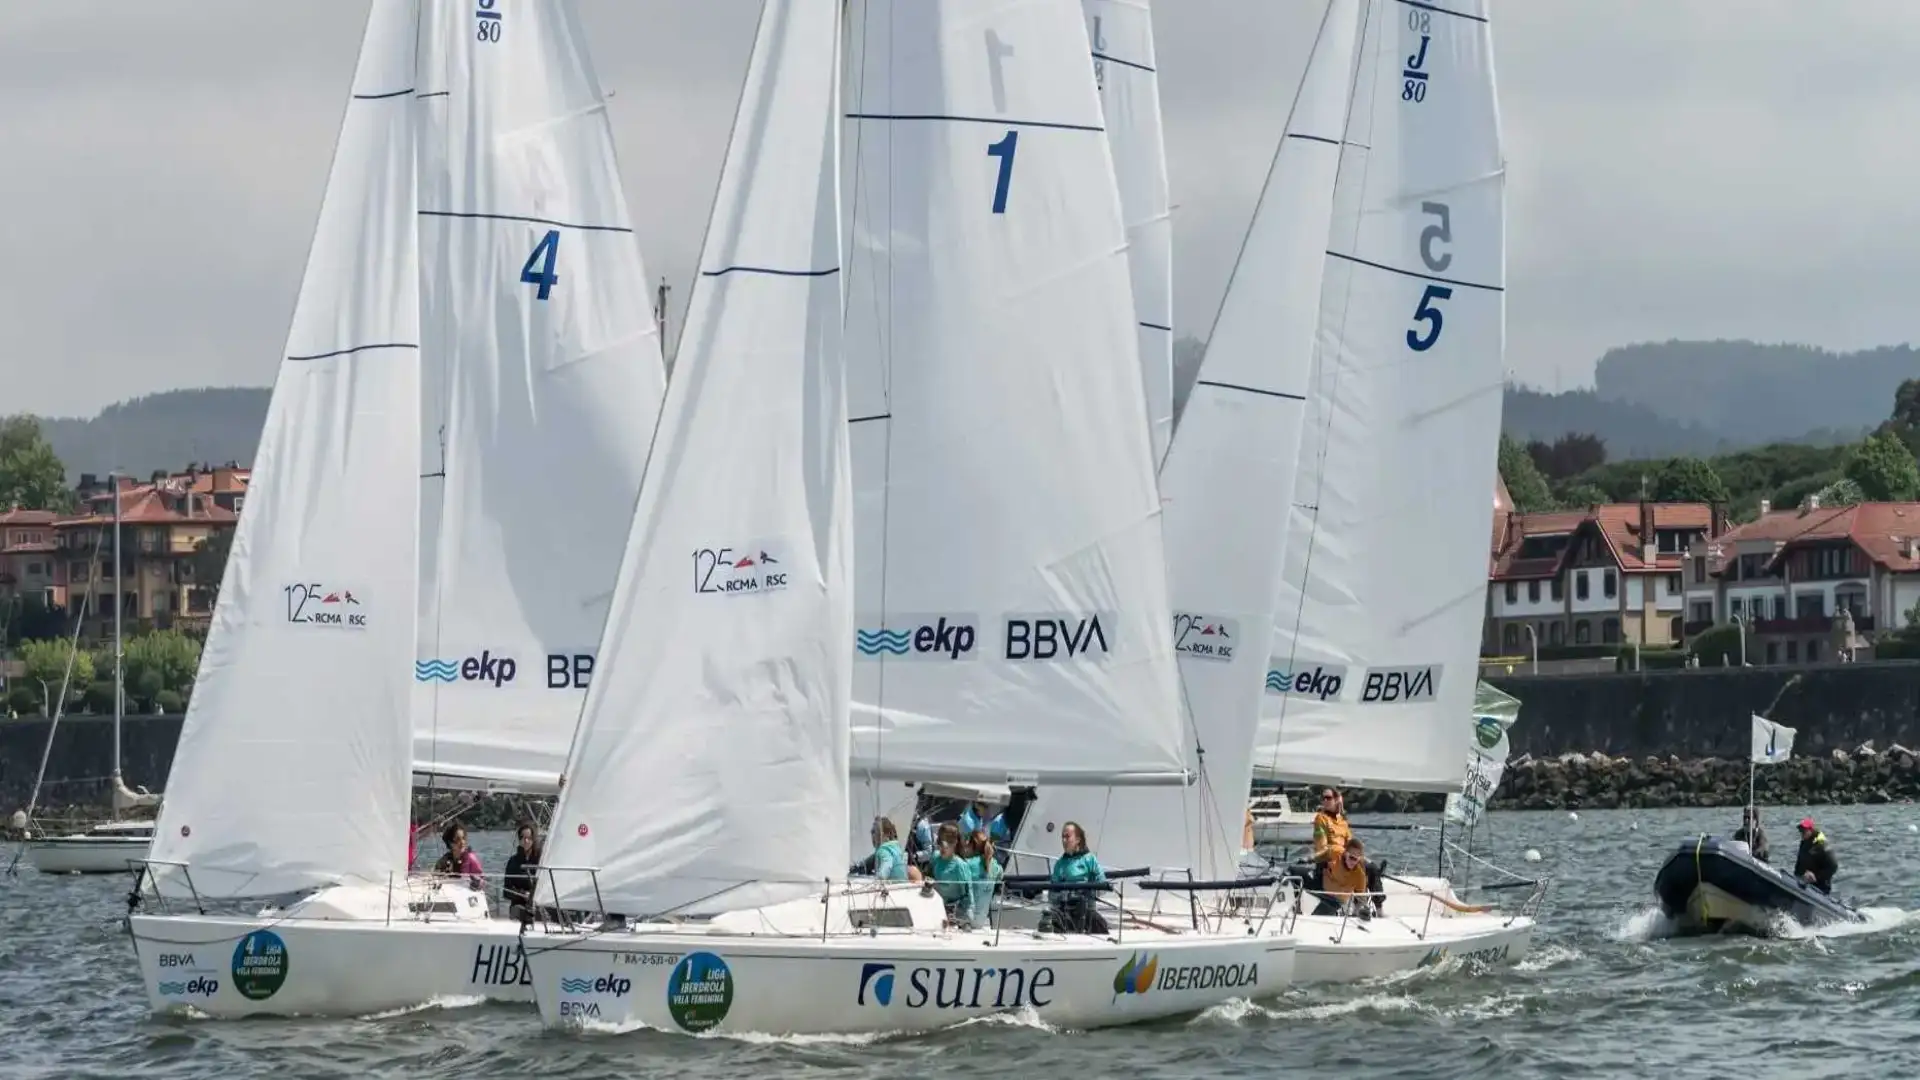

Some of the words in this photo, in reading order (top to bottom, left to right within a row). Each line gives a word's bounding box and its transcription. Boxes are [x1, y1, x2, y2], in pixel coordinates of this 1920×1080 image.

[477, 20, 501, 43] 80
[1407, 35, 1430, 69] J
[1401, 79, 1426, 103] 80
[988, 131, 1018, 214] 1
[520, 230, 560, 301] 4
[1406, 285, 1452, 352] 5
[726, 577, 758, 592] RCMA
[766, 573, 788, 587] RSC
[315, 612, 342, 624] RCMA
[348, 614, 367, 626] RSC
[914, 616, 976, 660] ekp
[1005, 613, 1109, 660] BBVA
[461, 649, 516, 688] ekp
[1295, 666, 1342, 701] ekp
[1362, 666, 1434, 702] BBVA
[159, 953, 196, 968] BBVA
[686, 959, 694, 981] 1
[707, 967, 726, 980] LIGA
[187, 976, 219, 997] ekp
[595, 973, 631, 998] ekp
[680, 981, 725, 994] IBERDROLA
[906, 965, 1055, 1009] surne
[1156, 961, 1259, 992] IBERDROLA
